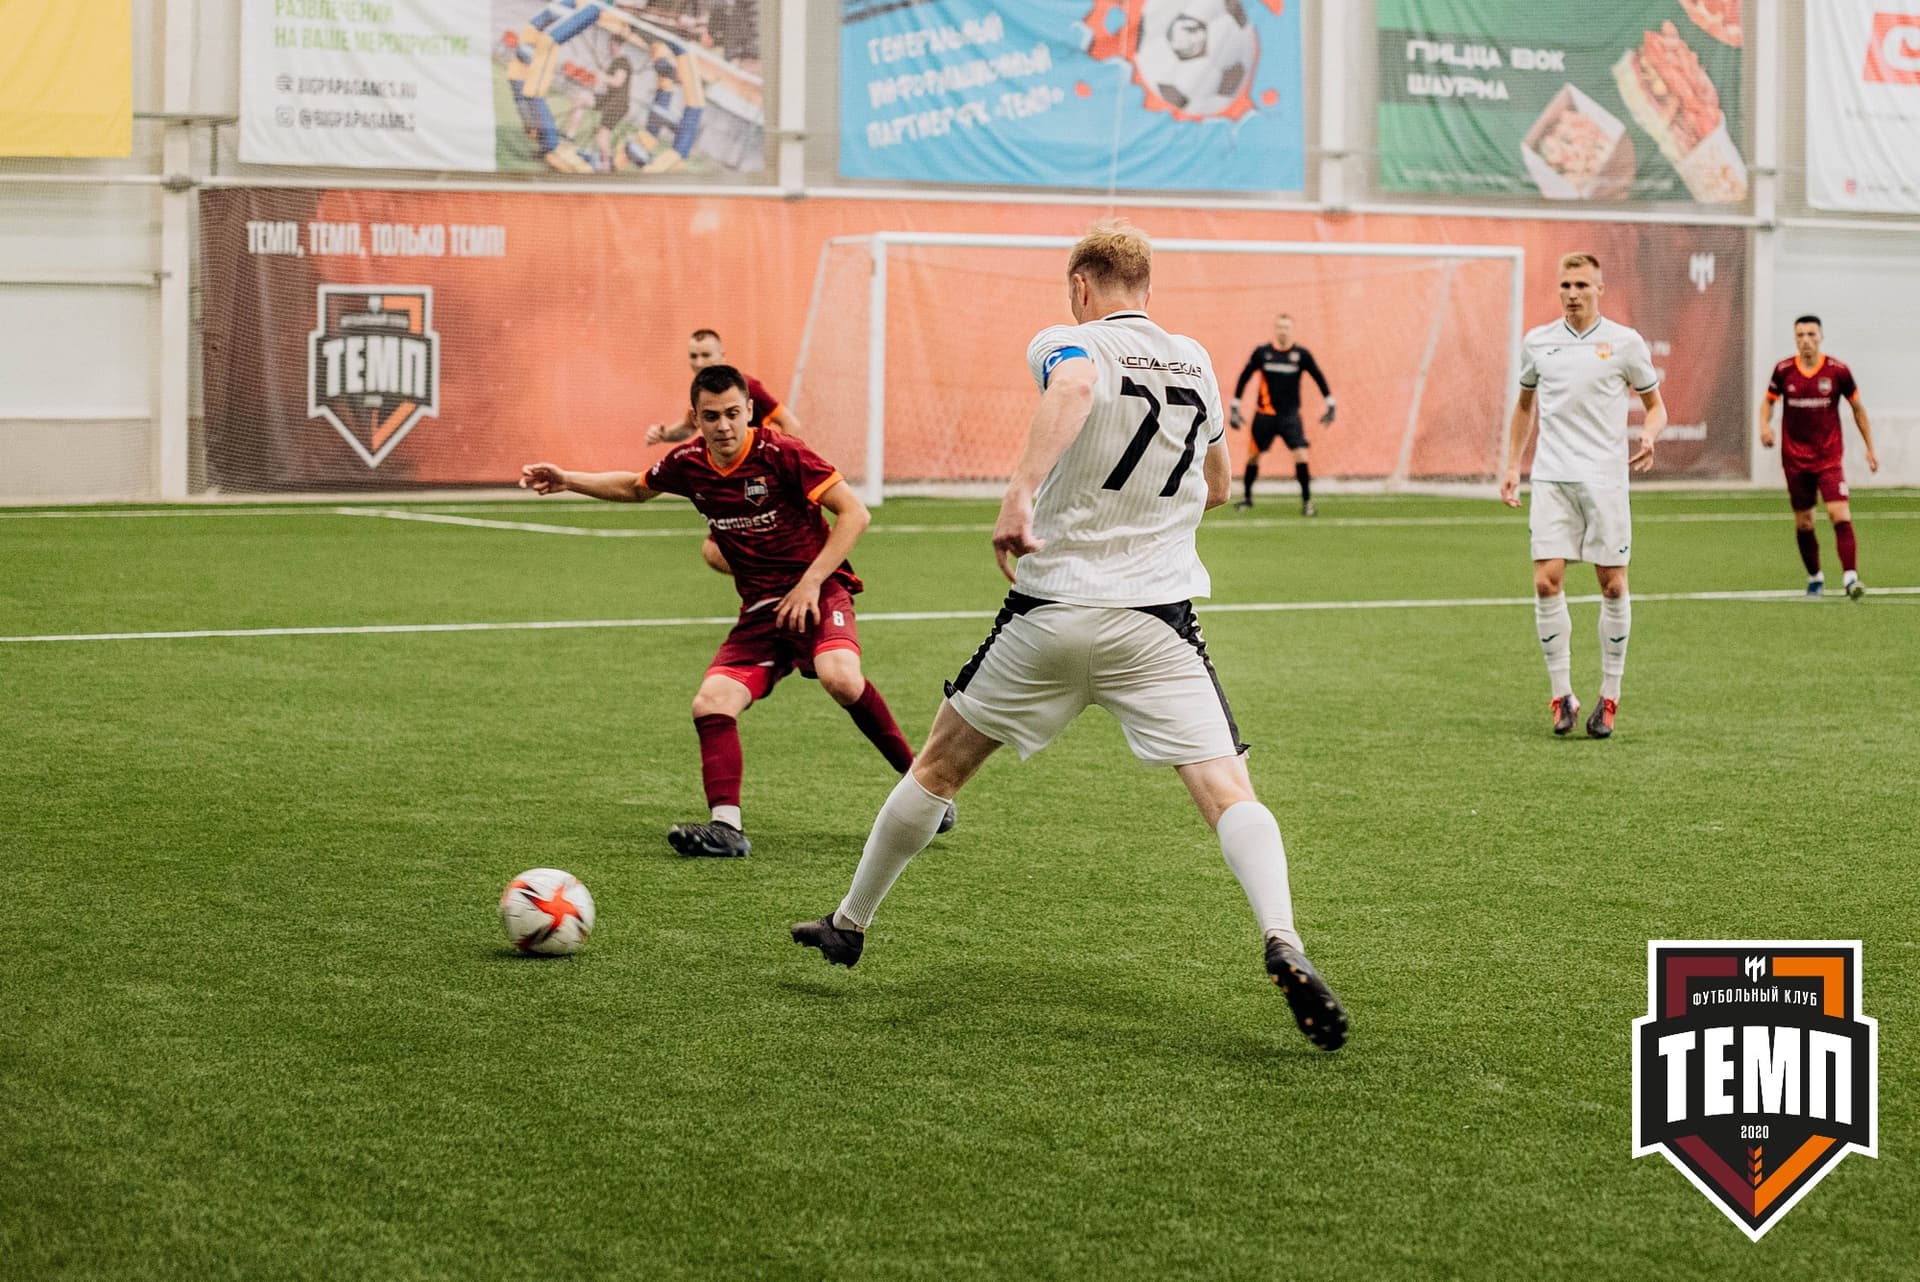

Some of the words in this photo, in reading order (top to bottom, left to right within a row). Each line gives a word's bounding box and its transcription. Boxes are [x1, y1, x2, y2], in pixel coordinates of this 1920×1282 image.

[274, 27, 296, 48] НА
[1406, 40, 1503, 70] ПИЦЦА
[1407, 73, 1509, 100] ШАУРМА
[247, 221, 304, 257] ТЕМП,
[308, 222, 366, 257] ТЕМП,
[371, 223, 445, 257] ТОЛЬКО
[448, 224, 506, 257] ТЕМП!
[322, 336, 428, 398] ТЕМП
[1101, 376, 1207, 497] 77
[831, 610, 846, 627] 8
